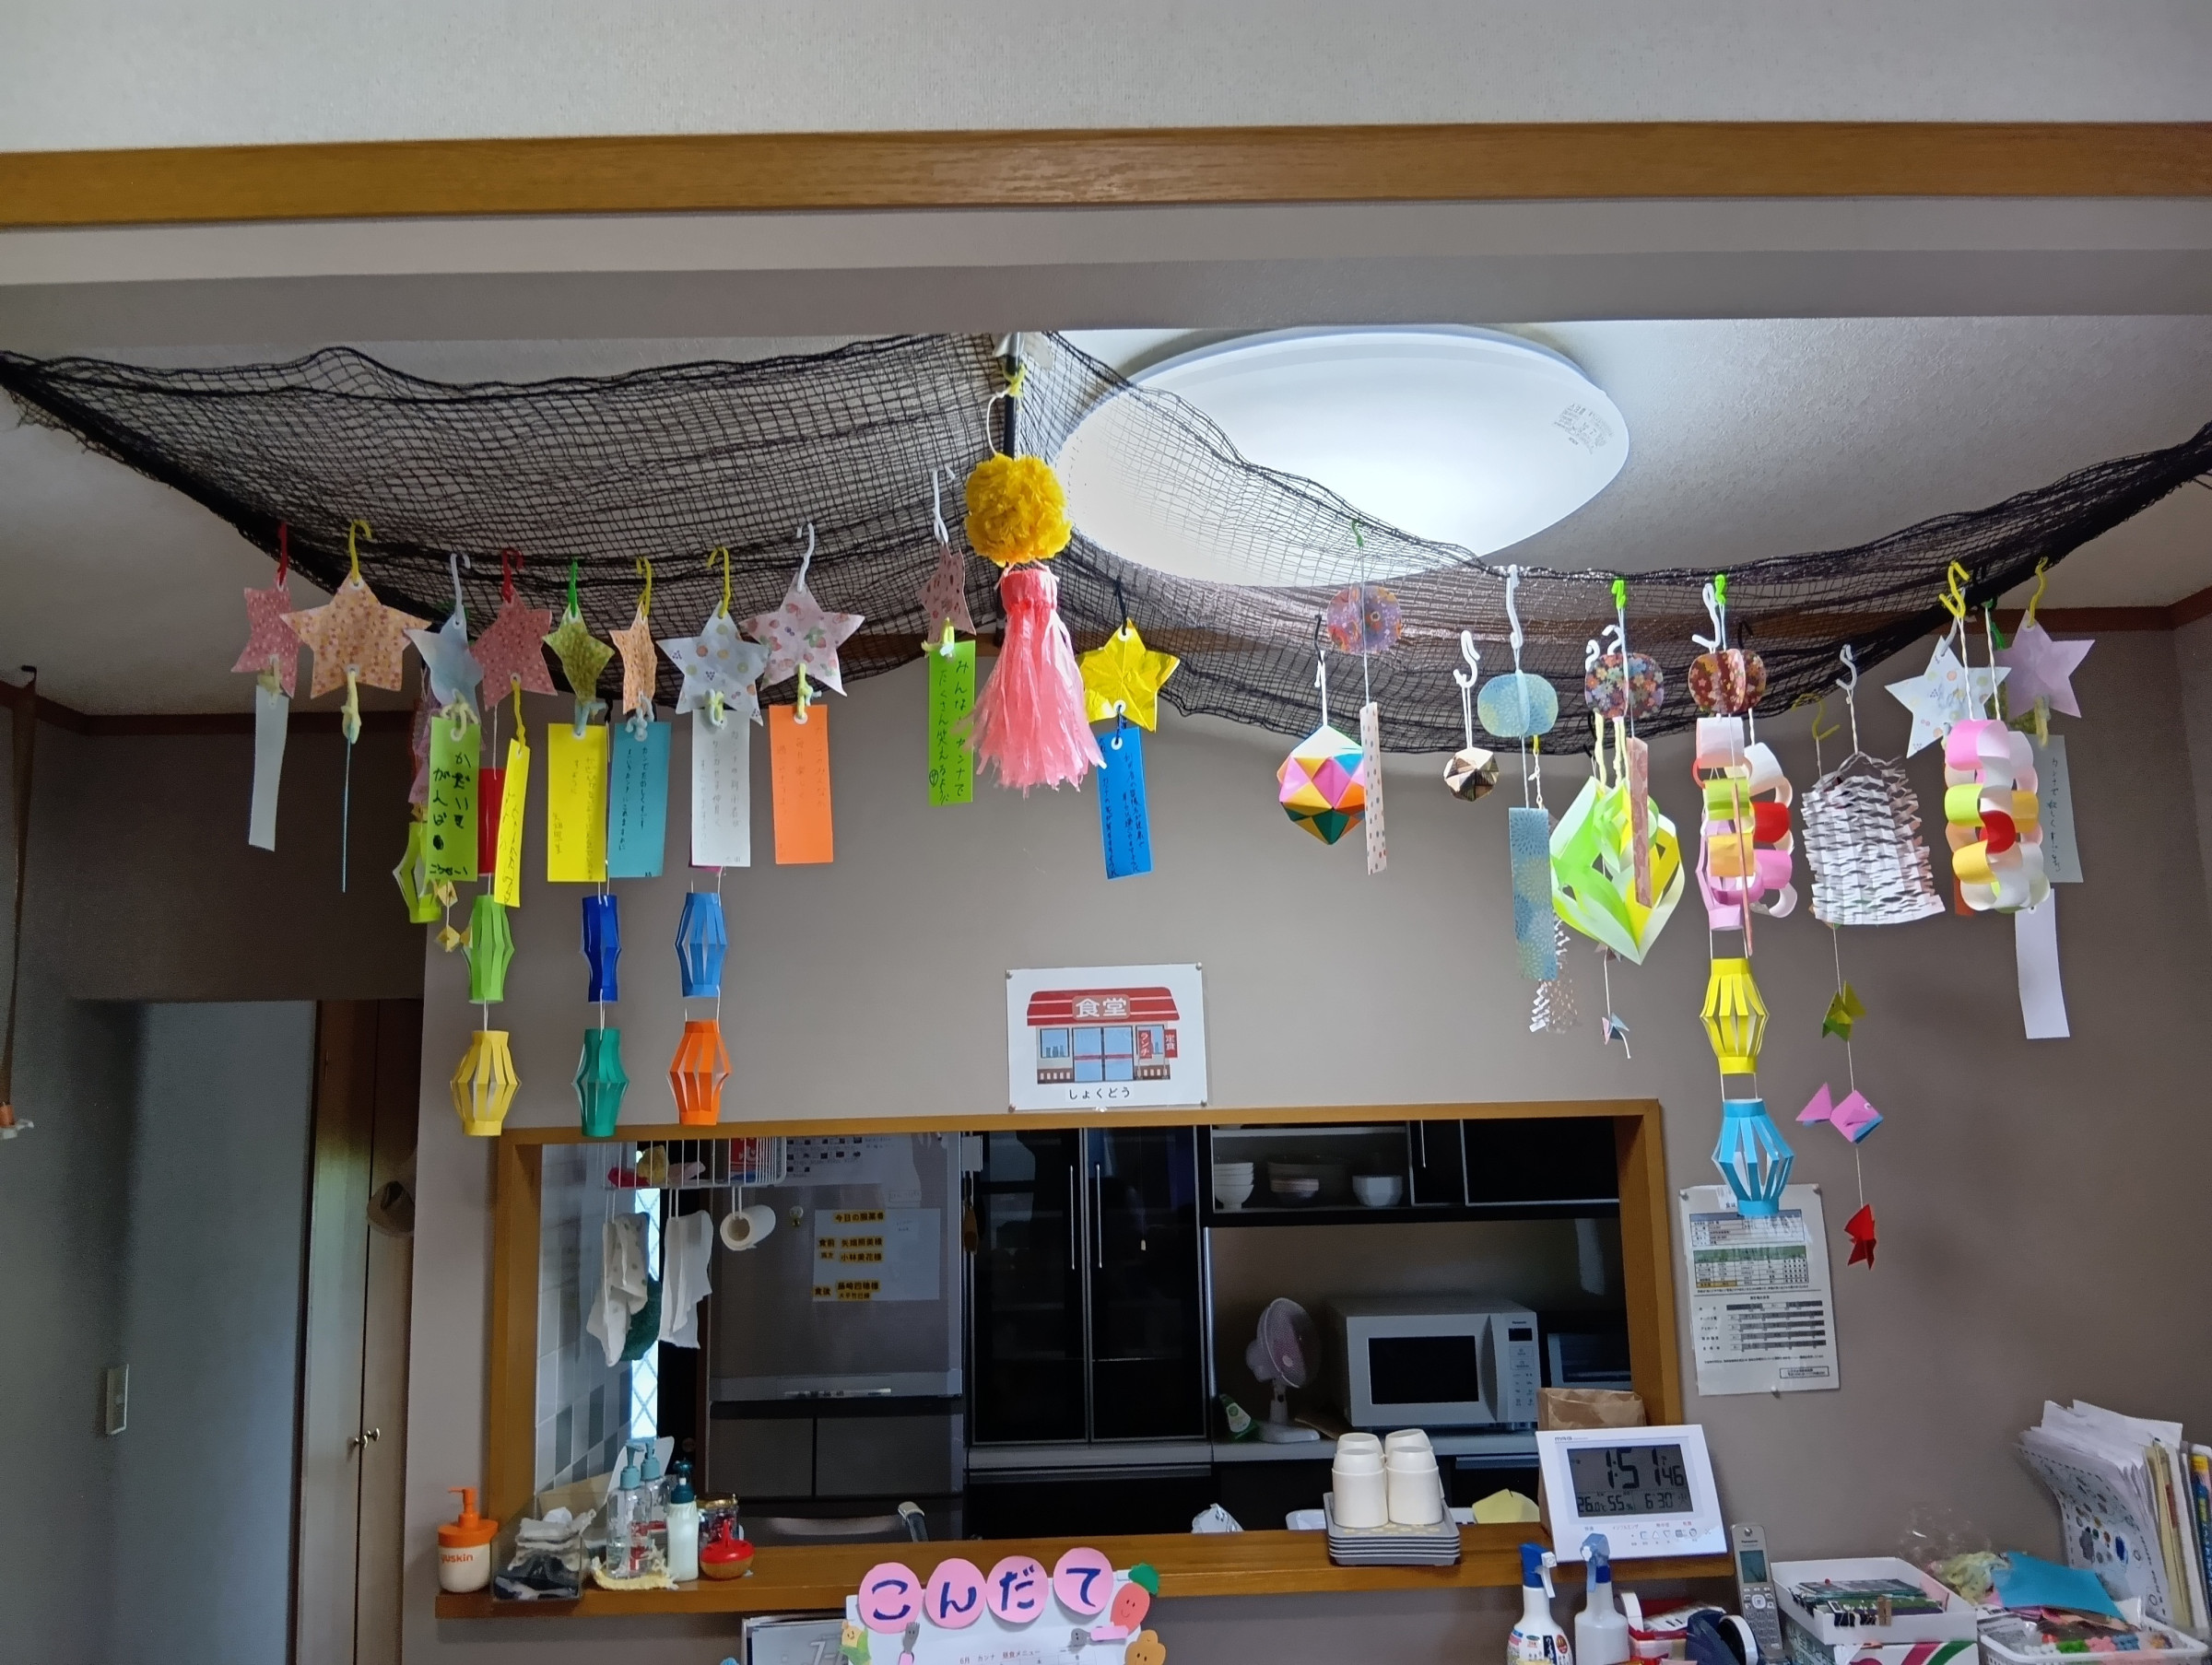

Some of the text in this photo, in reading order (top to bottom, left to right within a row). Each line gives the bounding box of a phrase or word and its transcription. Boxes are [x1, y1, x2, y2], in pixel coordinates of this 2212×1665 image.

[1076, 997, 1127, 1017] 食堂
[1140, 1032, 1151, 1057] ランチ
[1165, 1034, 1176, 1050] 定食
[1069, 1086, 1130, 1100] しょくどう
[1605, 1448, 1662, 1489] 1:51
[870, 1565, 1102, 1621] こんだて
